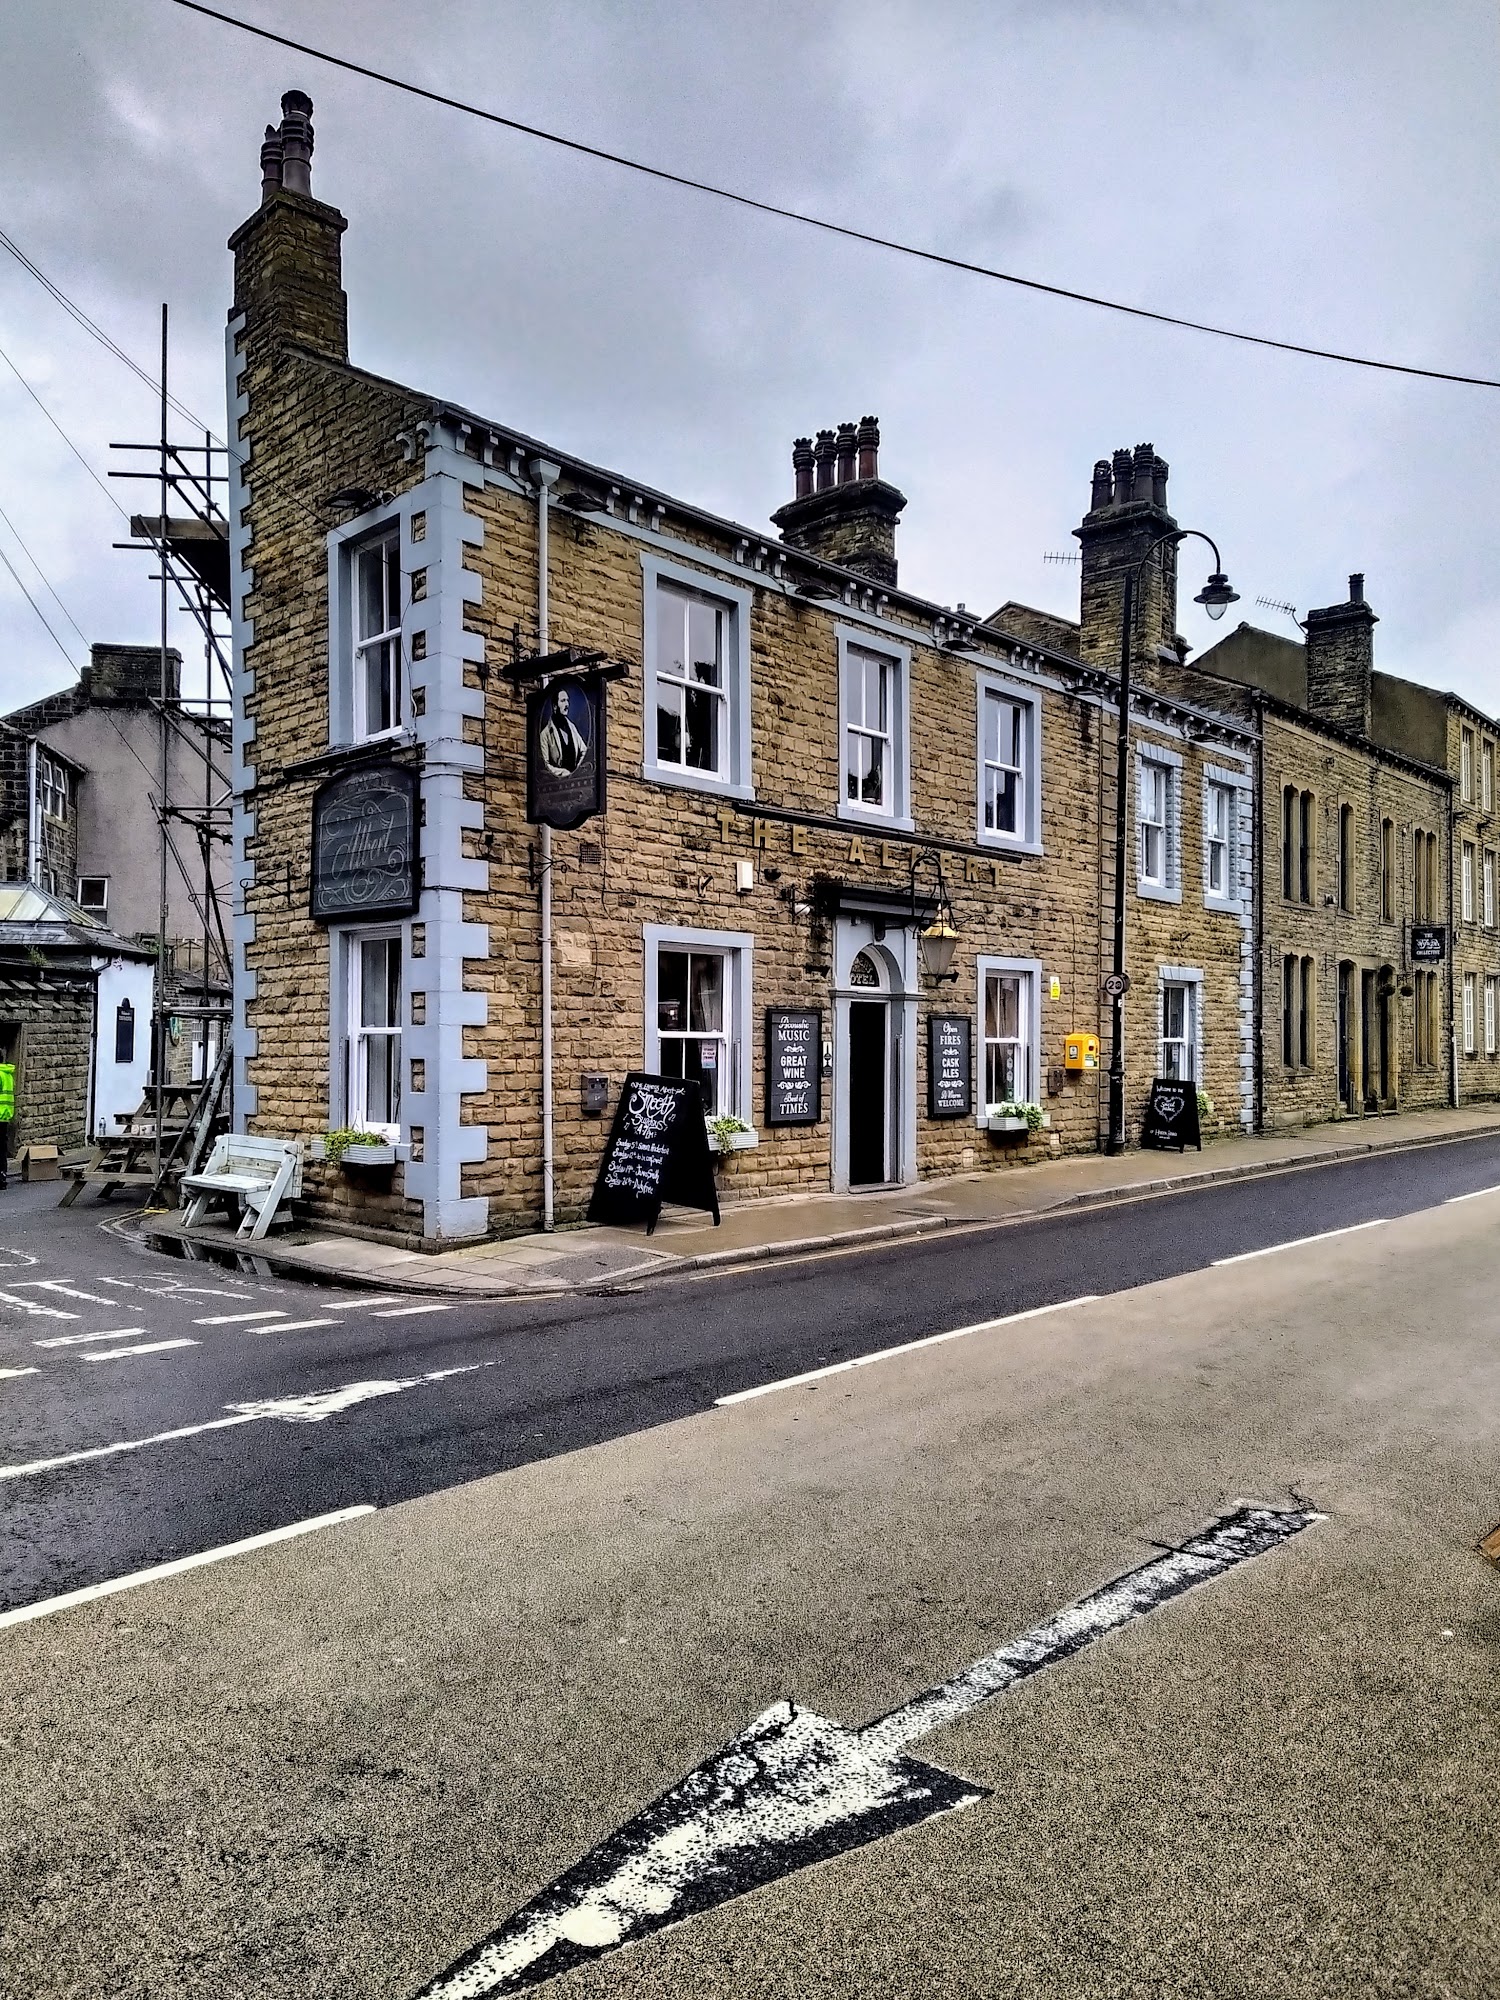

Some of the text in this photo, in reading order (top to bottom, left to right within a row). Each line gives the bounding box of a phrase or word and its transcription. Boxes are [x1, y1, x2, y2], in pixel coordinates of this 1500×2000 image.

[332, 813, 394, 880] Albert
[717, 813, 1003, 885] THE ALBERT
[1107, 980, 1122, 990] 20
[779, 1016, 809, 1029] Acoustic
[943, 1021, 958, 1035] Open
[778, 1030, 810, 1041] MUSIC
[940, 1035, 961, 1045] FIRES
[780, 1055, 808, 1067] GREAT
[942, 1058, 960, 1067] CASK
[783, 1067, 805, 1079] WINE
[942, 1068, 960, 1078] ALES
[784, 1092, 806, 1104] Best of
[938, 1099, 964, 1107] WELCOME
[628, 1090, 676, 1119] Smooth
[779, 1103, 809, 1115] TIMES
